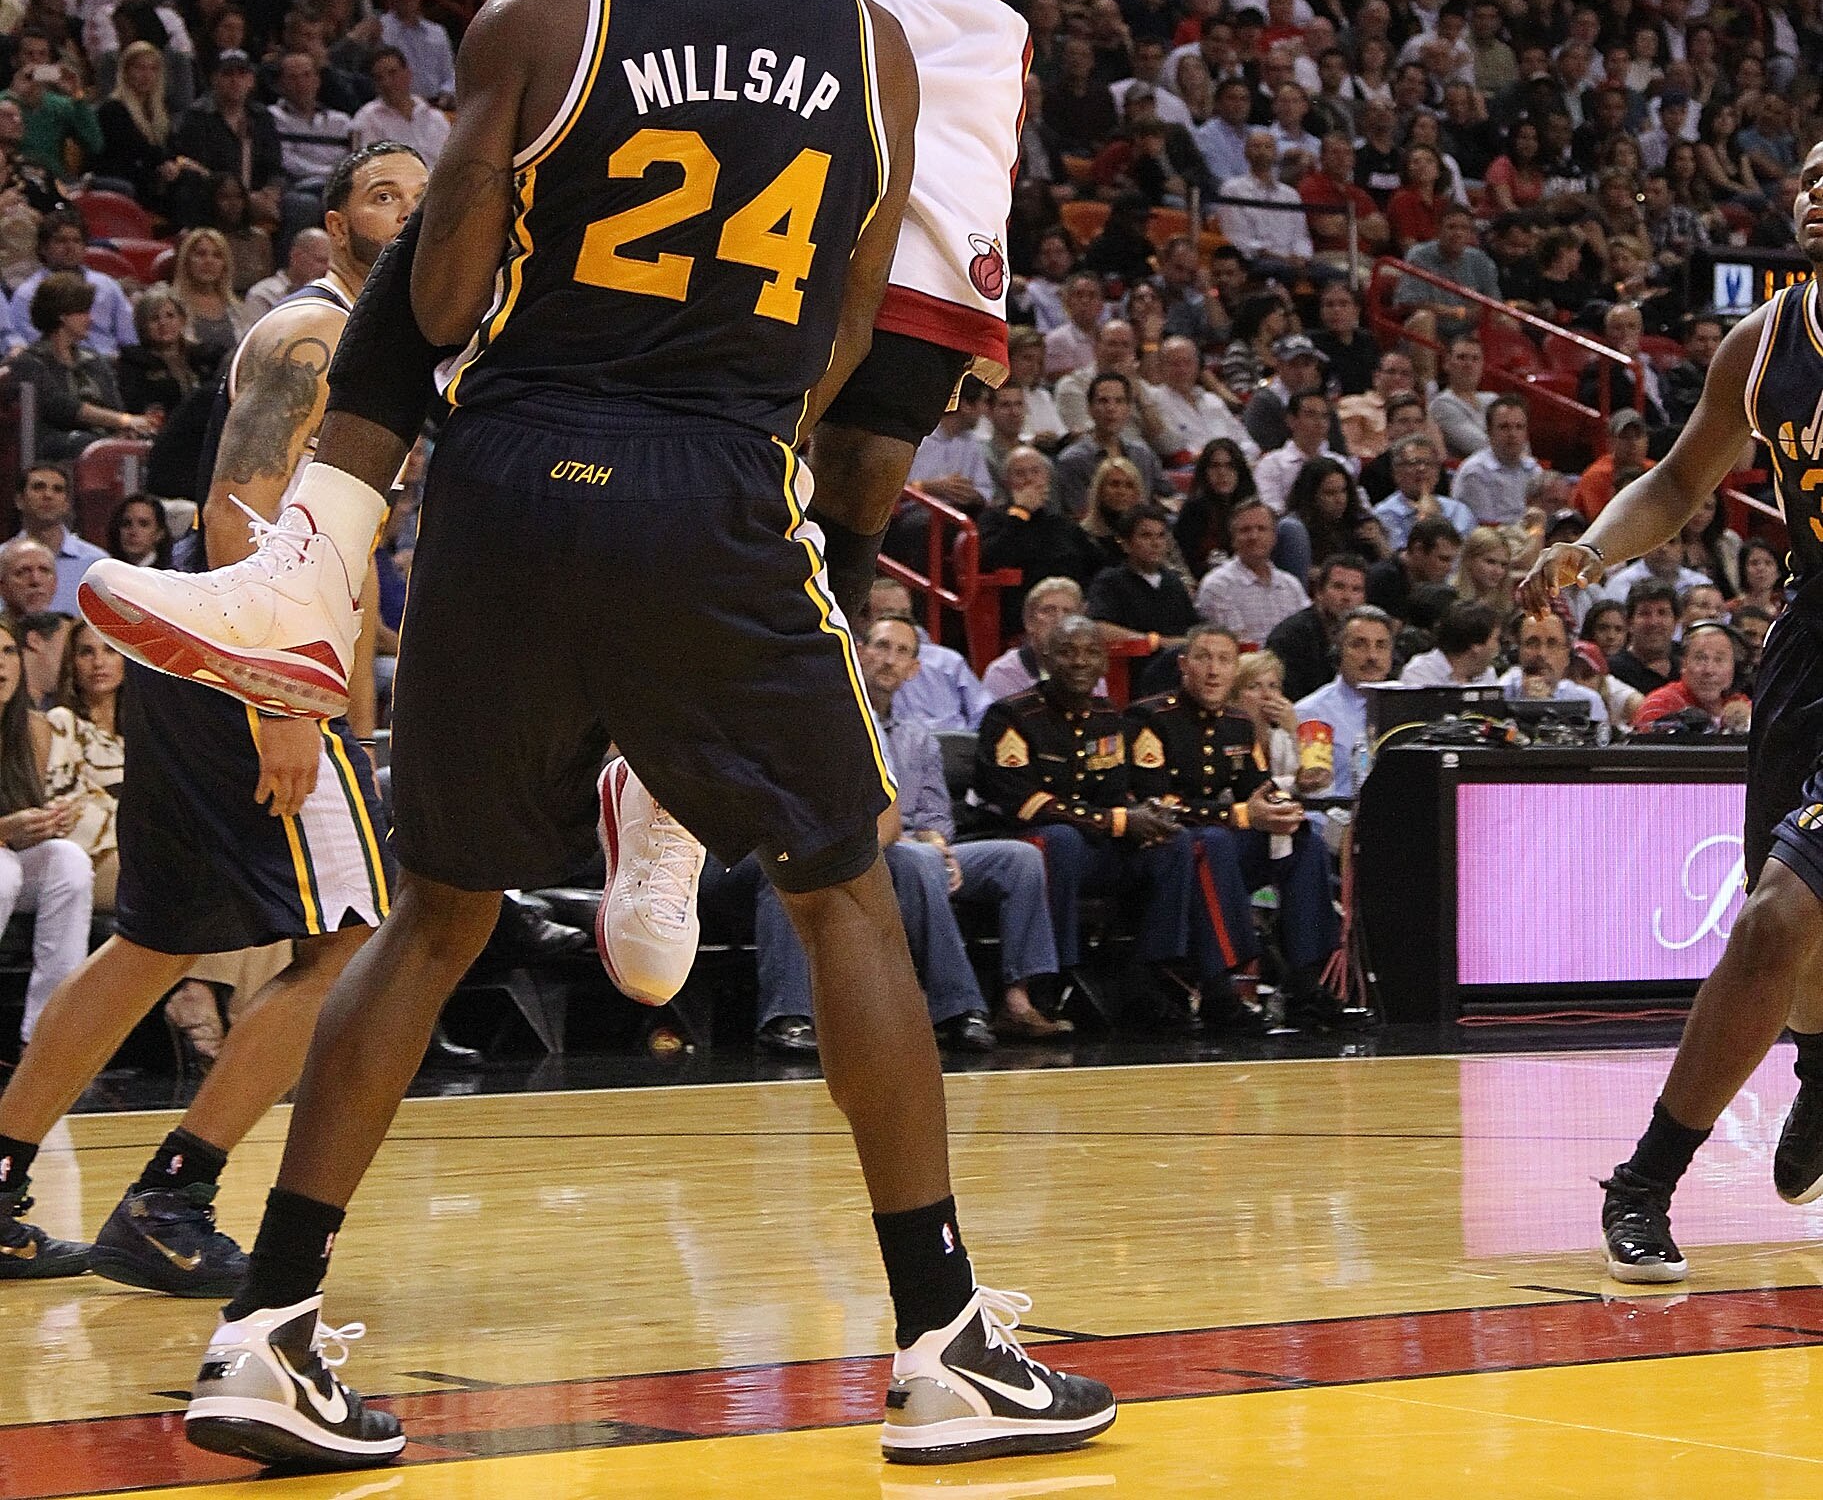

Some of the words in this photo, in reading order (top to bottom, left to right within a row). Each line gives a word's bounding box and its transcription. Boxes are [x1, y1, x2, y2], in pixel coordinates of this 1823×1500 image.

[621, 44, 841, 120] MILLSAP
[572, 128, 832, 326] 24
[549, 460, 614, 486] UTAH
